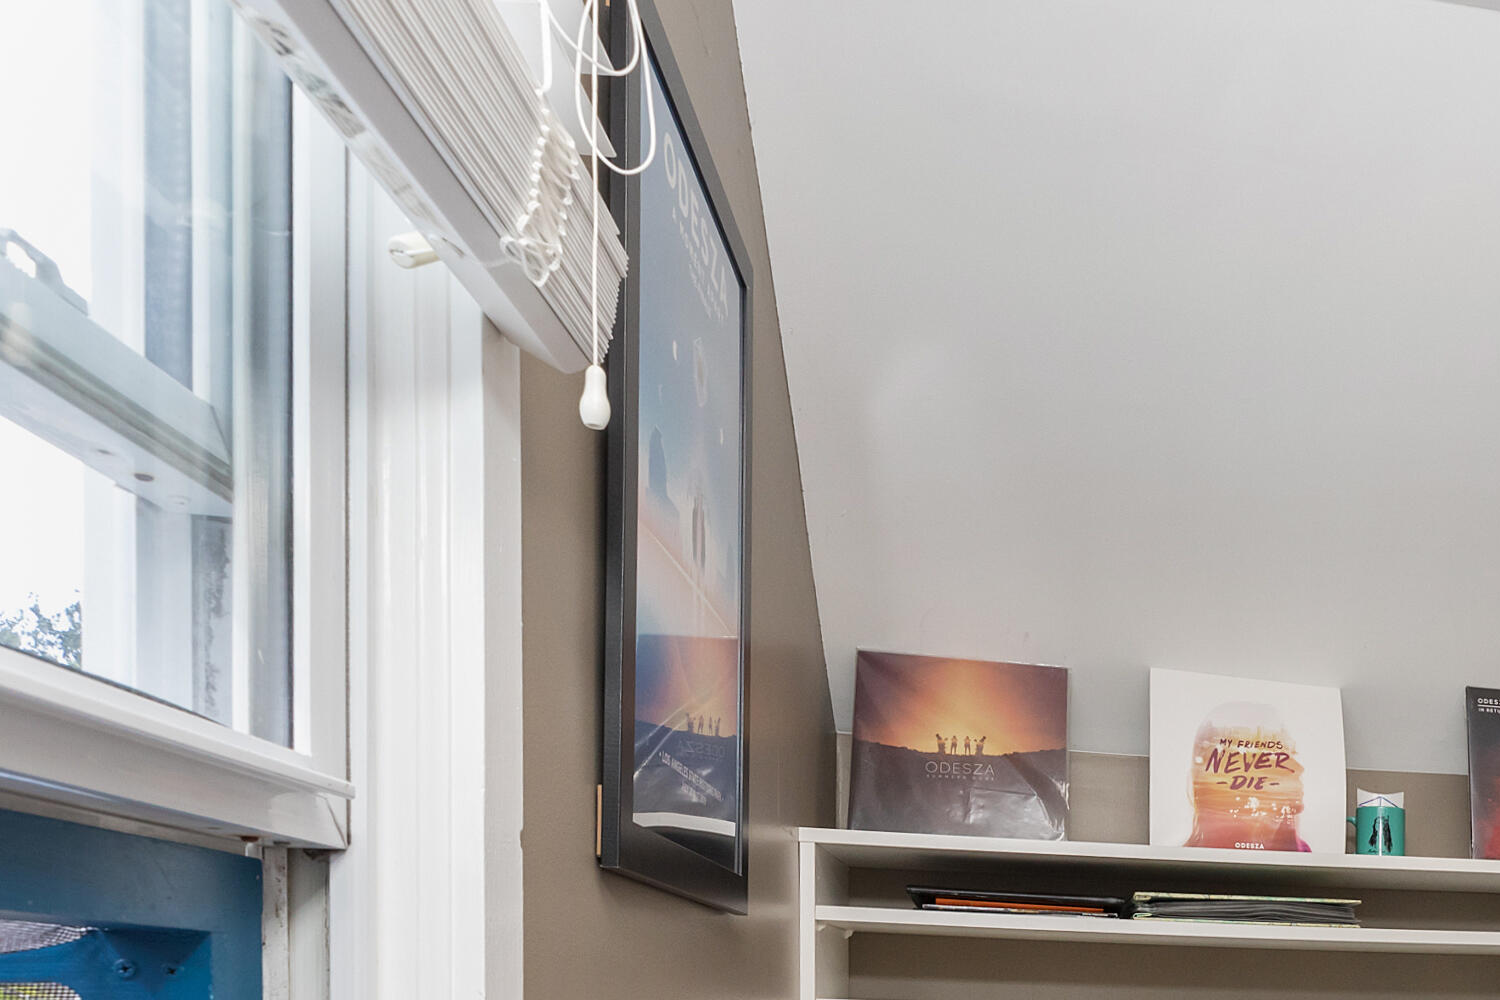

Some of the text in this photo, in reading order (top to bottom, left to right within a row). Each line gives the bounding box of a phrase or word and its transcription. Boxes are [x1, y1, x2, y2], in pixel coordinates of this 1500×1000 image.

[664, 132, 728, 327] ODESZA
[1220, 739, 1283, 750] MY FRIENDS
[925, 761, 995, 776] ODESZA
[1205, 748, 1295, 774] NEVER
